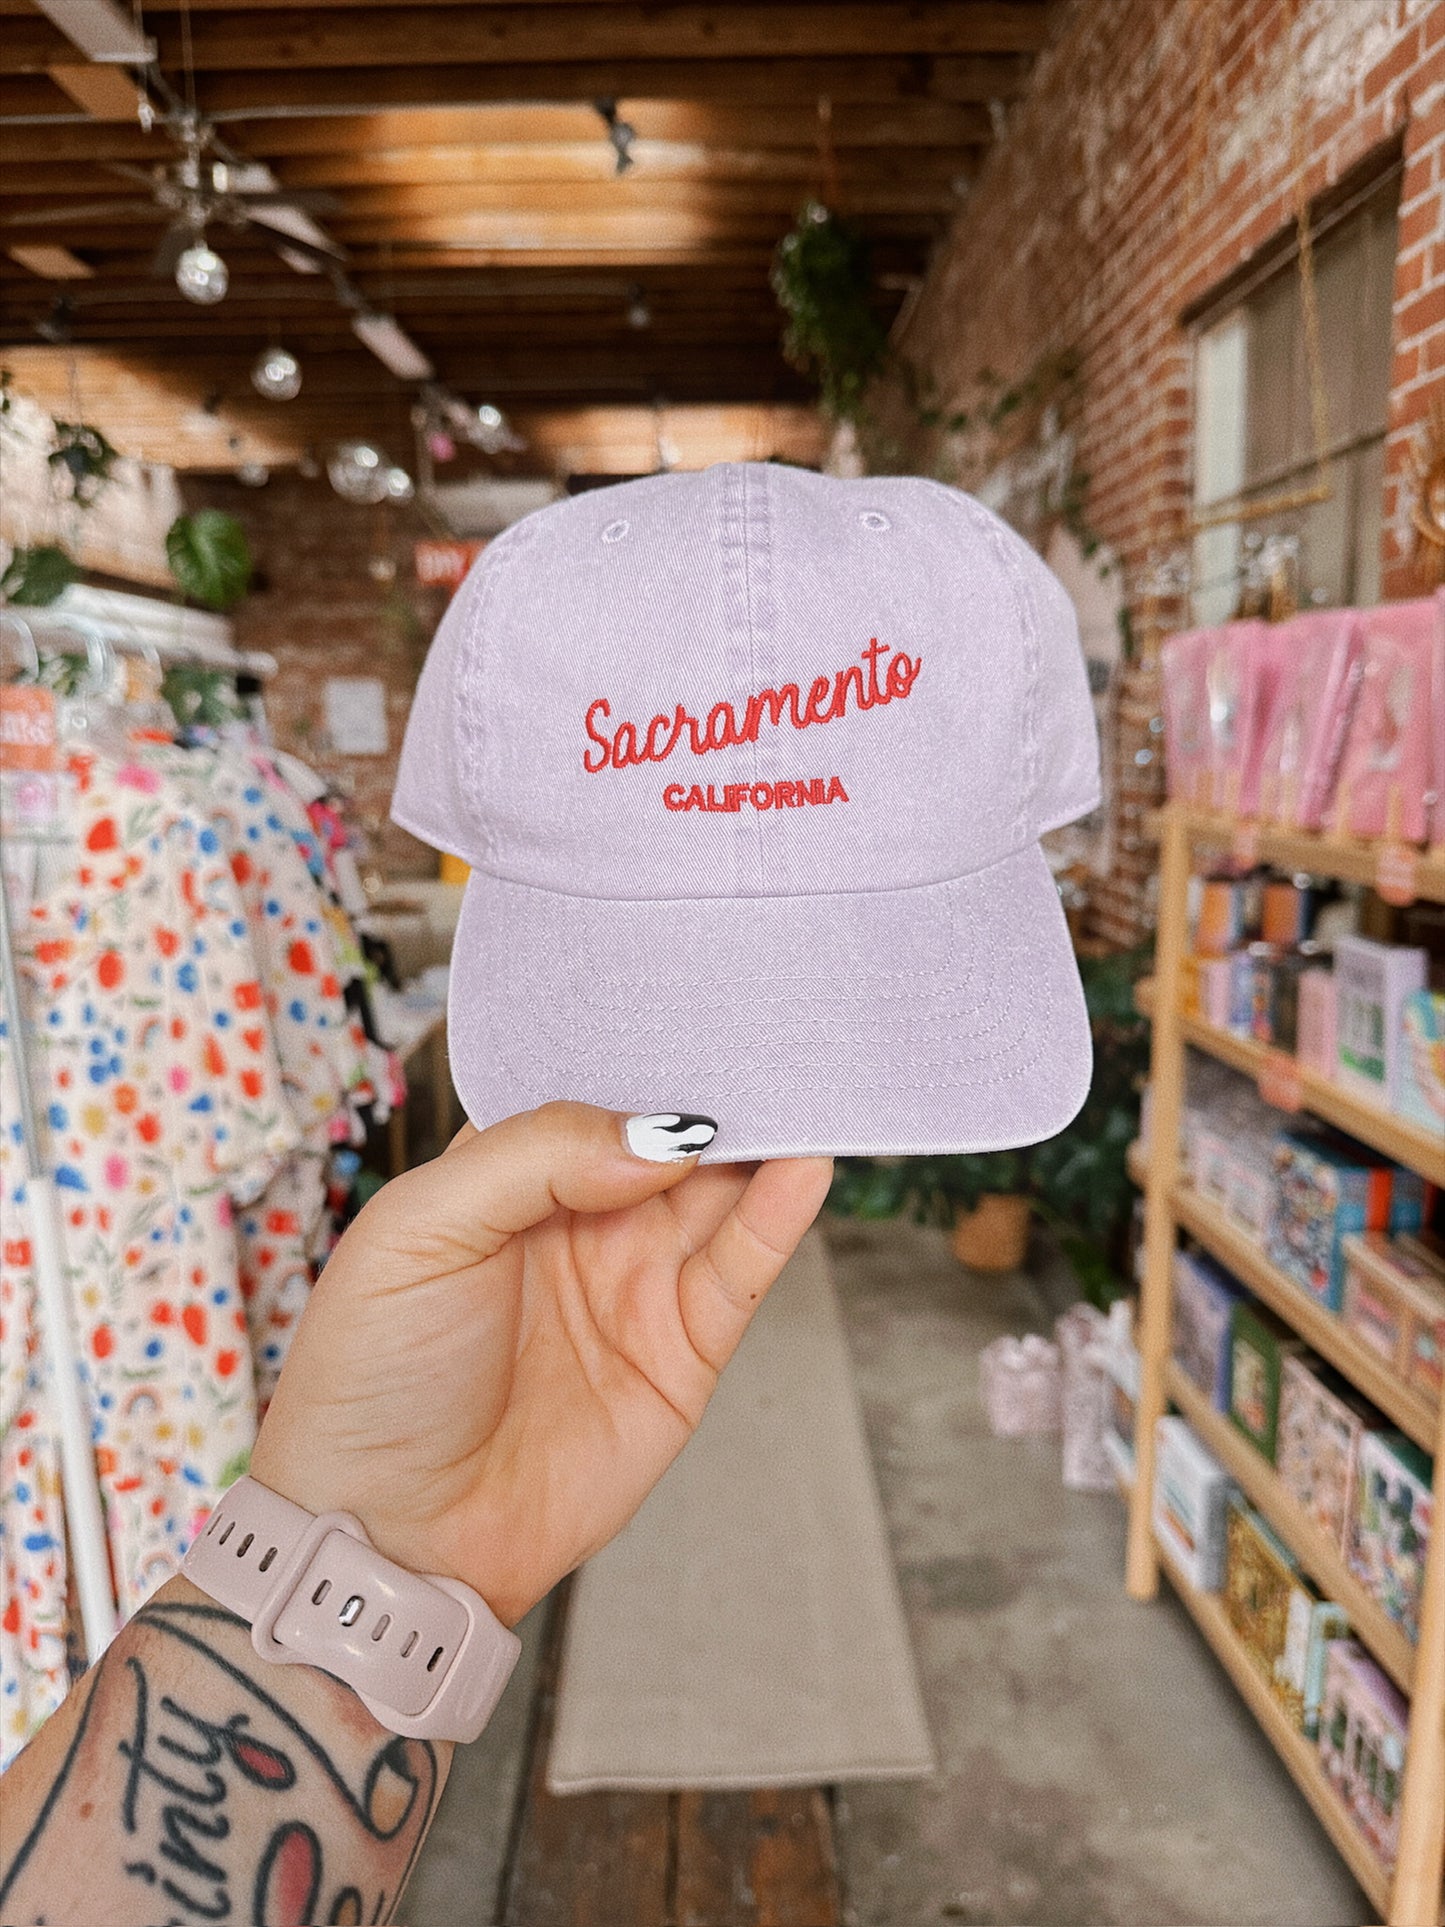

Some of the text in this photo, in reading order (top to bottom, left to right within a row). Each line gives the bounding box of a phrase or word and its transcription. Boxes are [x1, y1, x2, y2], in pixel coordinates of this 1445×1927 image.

[584, 638, 921, 773] Sacramento
[663, 777, 848, 812] CALIFORNIA
[118, 1657, 296, 1927] inty
